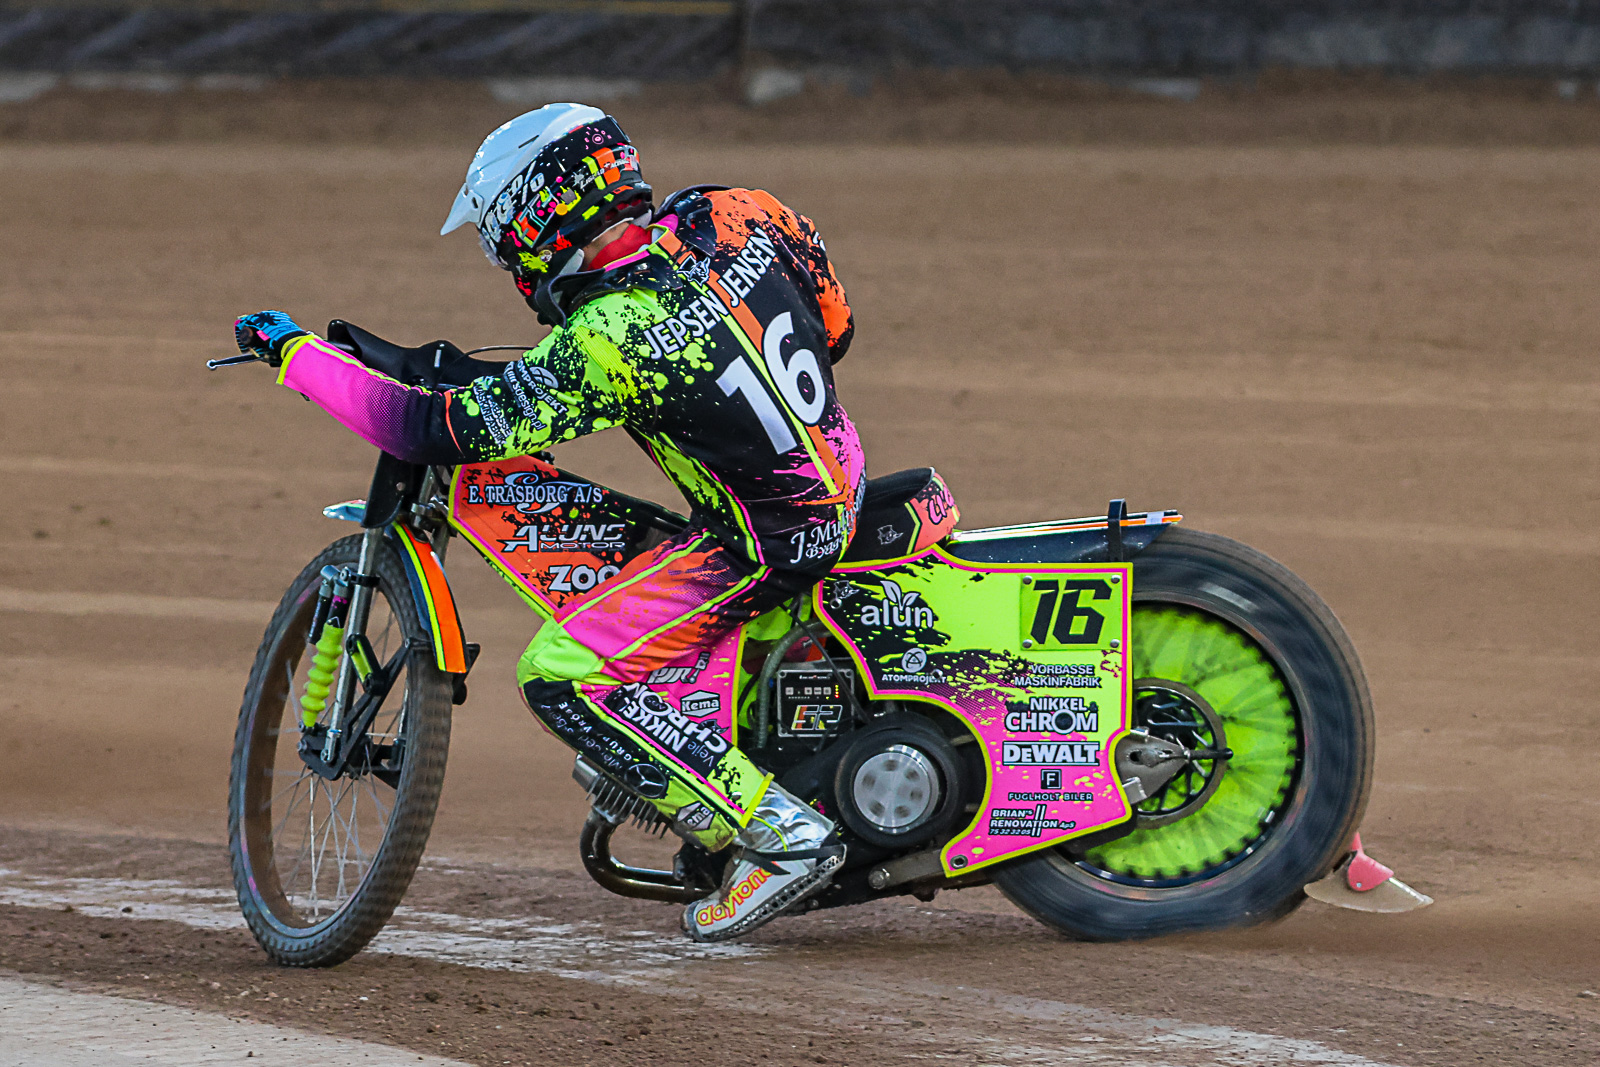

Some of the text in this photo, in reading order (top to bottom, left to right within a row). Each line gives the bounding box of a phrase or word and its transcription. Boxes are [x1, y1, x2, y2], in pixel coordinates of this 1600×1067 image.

[643, 226, 777, 360] JEPSEN JENSEN
[715, 311, 826, 455] 16
[468, 485, 603, 504] E. TRASBORG A/S
[540, 541, 626, 550] MOTOR
[860, 598, 933, 628] alun
[1030, 579, 1112, 644] 16
[1030, 664, 1094, 675] VORBASSE
[1013, 676, 1101, 688] MASKINFABRIK
[681, 699, 720, 713] Kema
[1029, 697, 1088, 711] NIKKEL
[1004, 710, 1098, 733] CHROM
[687, 741, 715, 767] Vejle
[1008, 793, 1093, 801] FUGLHOLT BILER
[686, 805, 711, 829] ema
[990, 819, 1058, 829] RENOVATION
